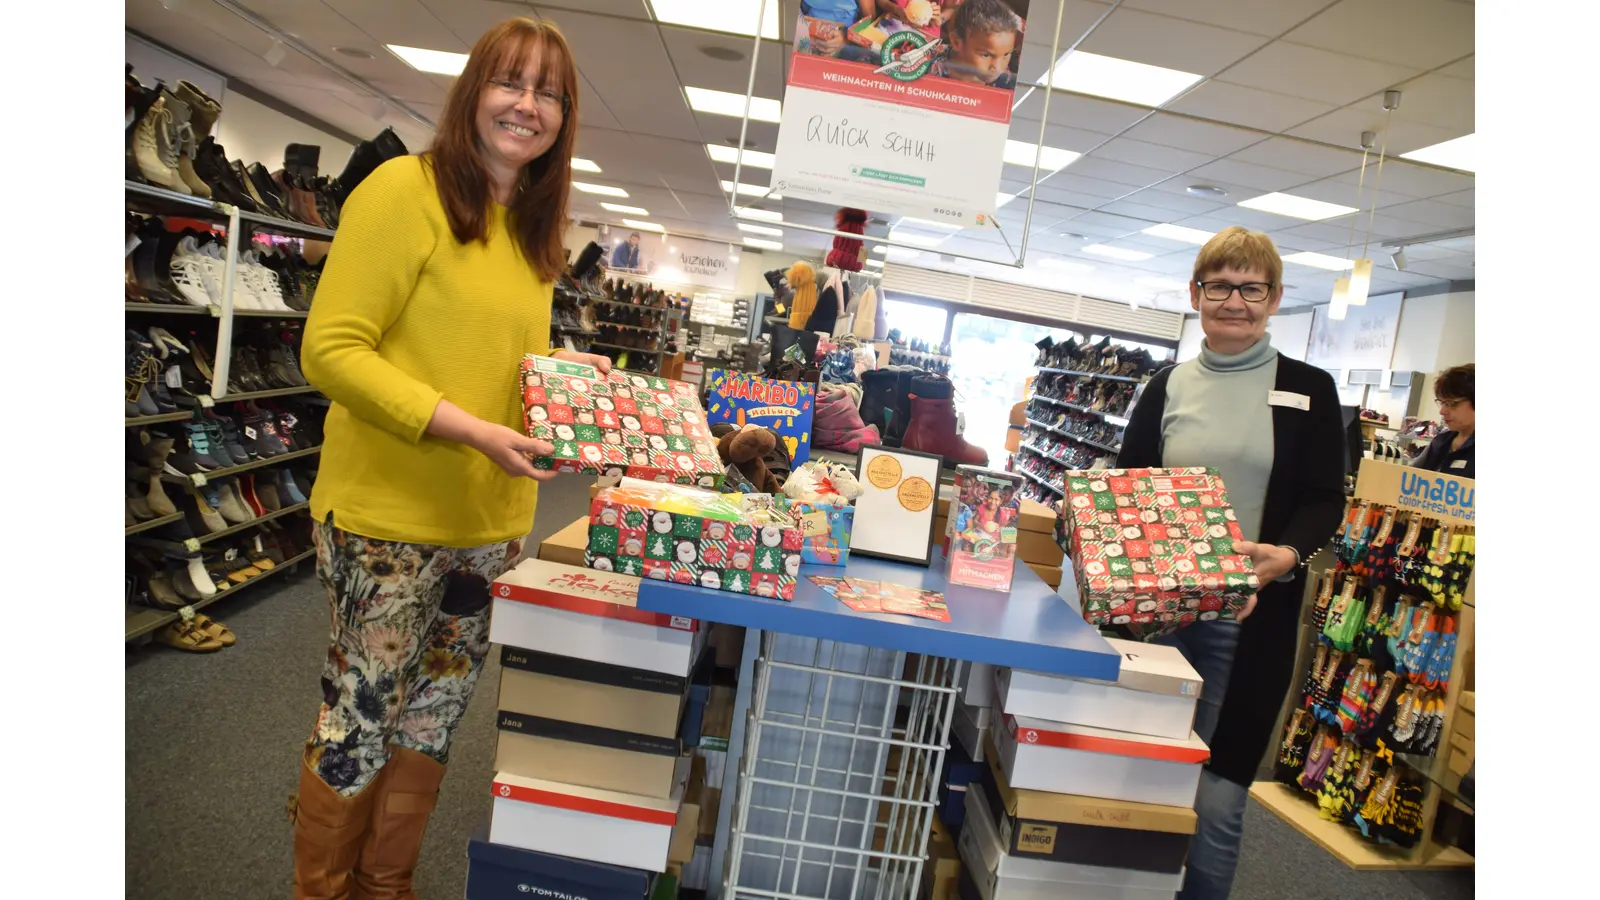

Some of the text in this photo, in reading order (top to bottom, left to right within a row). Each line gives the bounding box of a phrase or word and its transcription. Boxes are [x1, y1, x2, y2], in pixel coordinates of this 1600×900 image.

[822, 71, 892, 92] WEIHNACHTEN
[893, 84, 905, 94] IM
[882, 132, 936, 162] SCHUH
[725, 377, 799, 406] HARIBO
[506, 654, 527, 665] Jana
[502, 717, 523, 728] Jana
[1022, 833, 1052, 845] INDIGO
[531, 886, 553, 897] TOM
